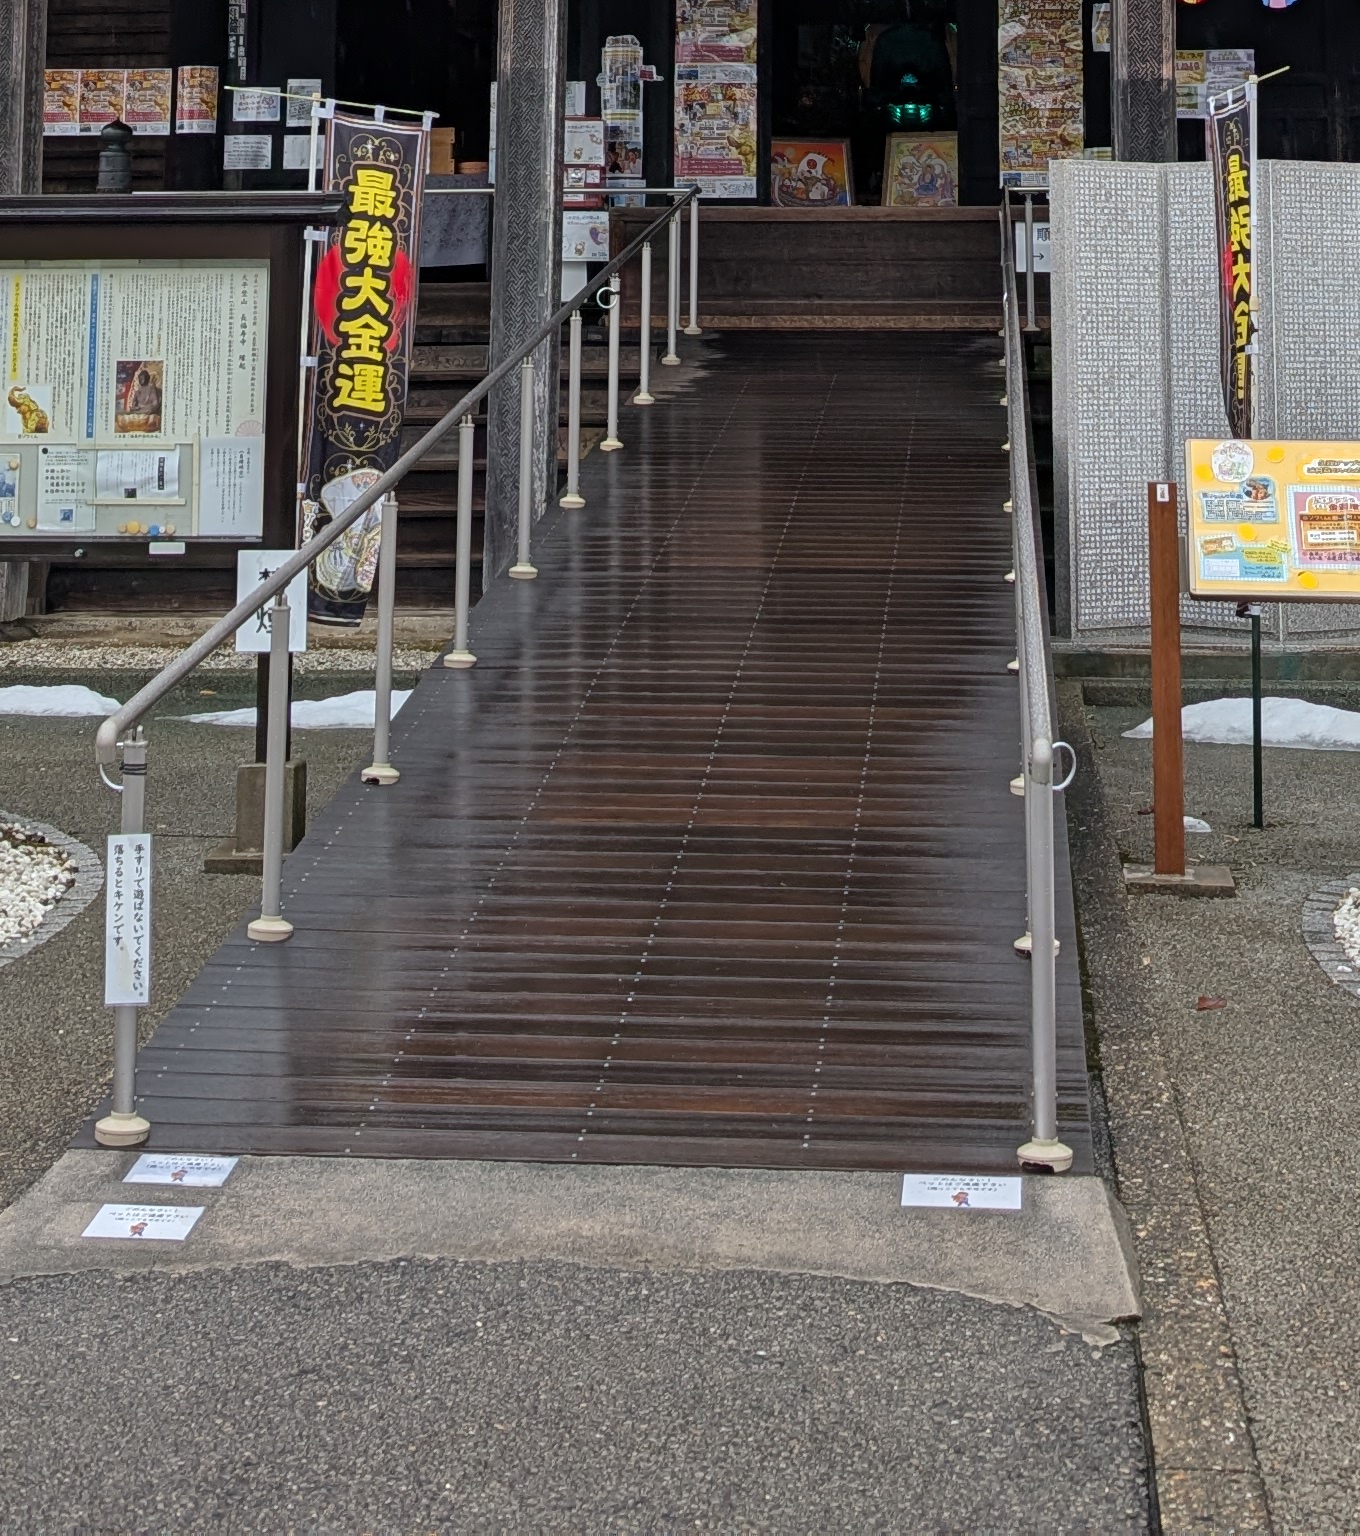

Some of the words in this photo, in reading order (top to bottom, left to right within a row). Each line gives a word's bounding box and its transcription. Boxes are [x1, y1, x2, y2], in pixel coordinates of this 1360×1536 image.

[333, 169, 395, 412] 最強大金運
[113, 844, 125, 952] 落ちるとキケンです。
[133, 843, 146, 998] 手すりで遊ばないでください。
